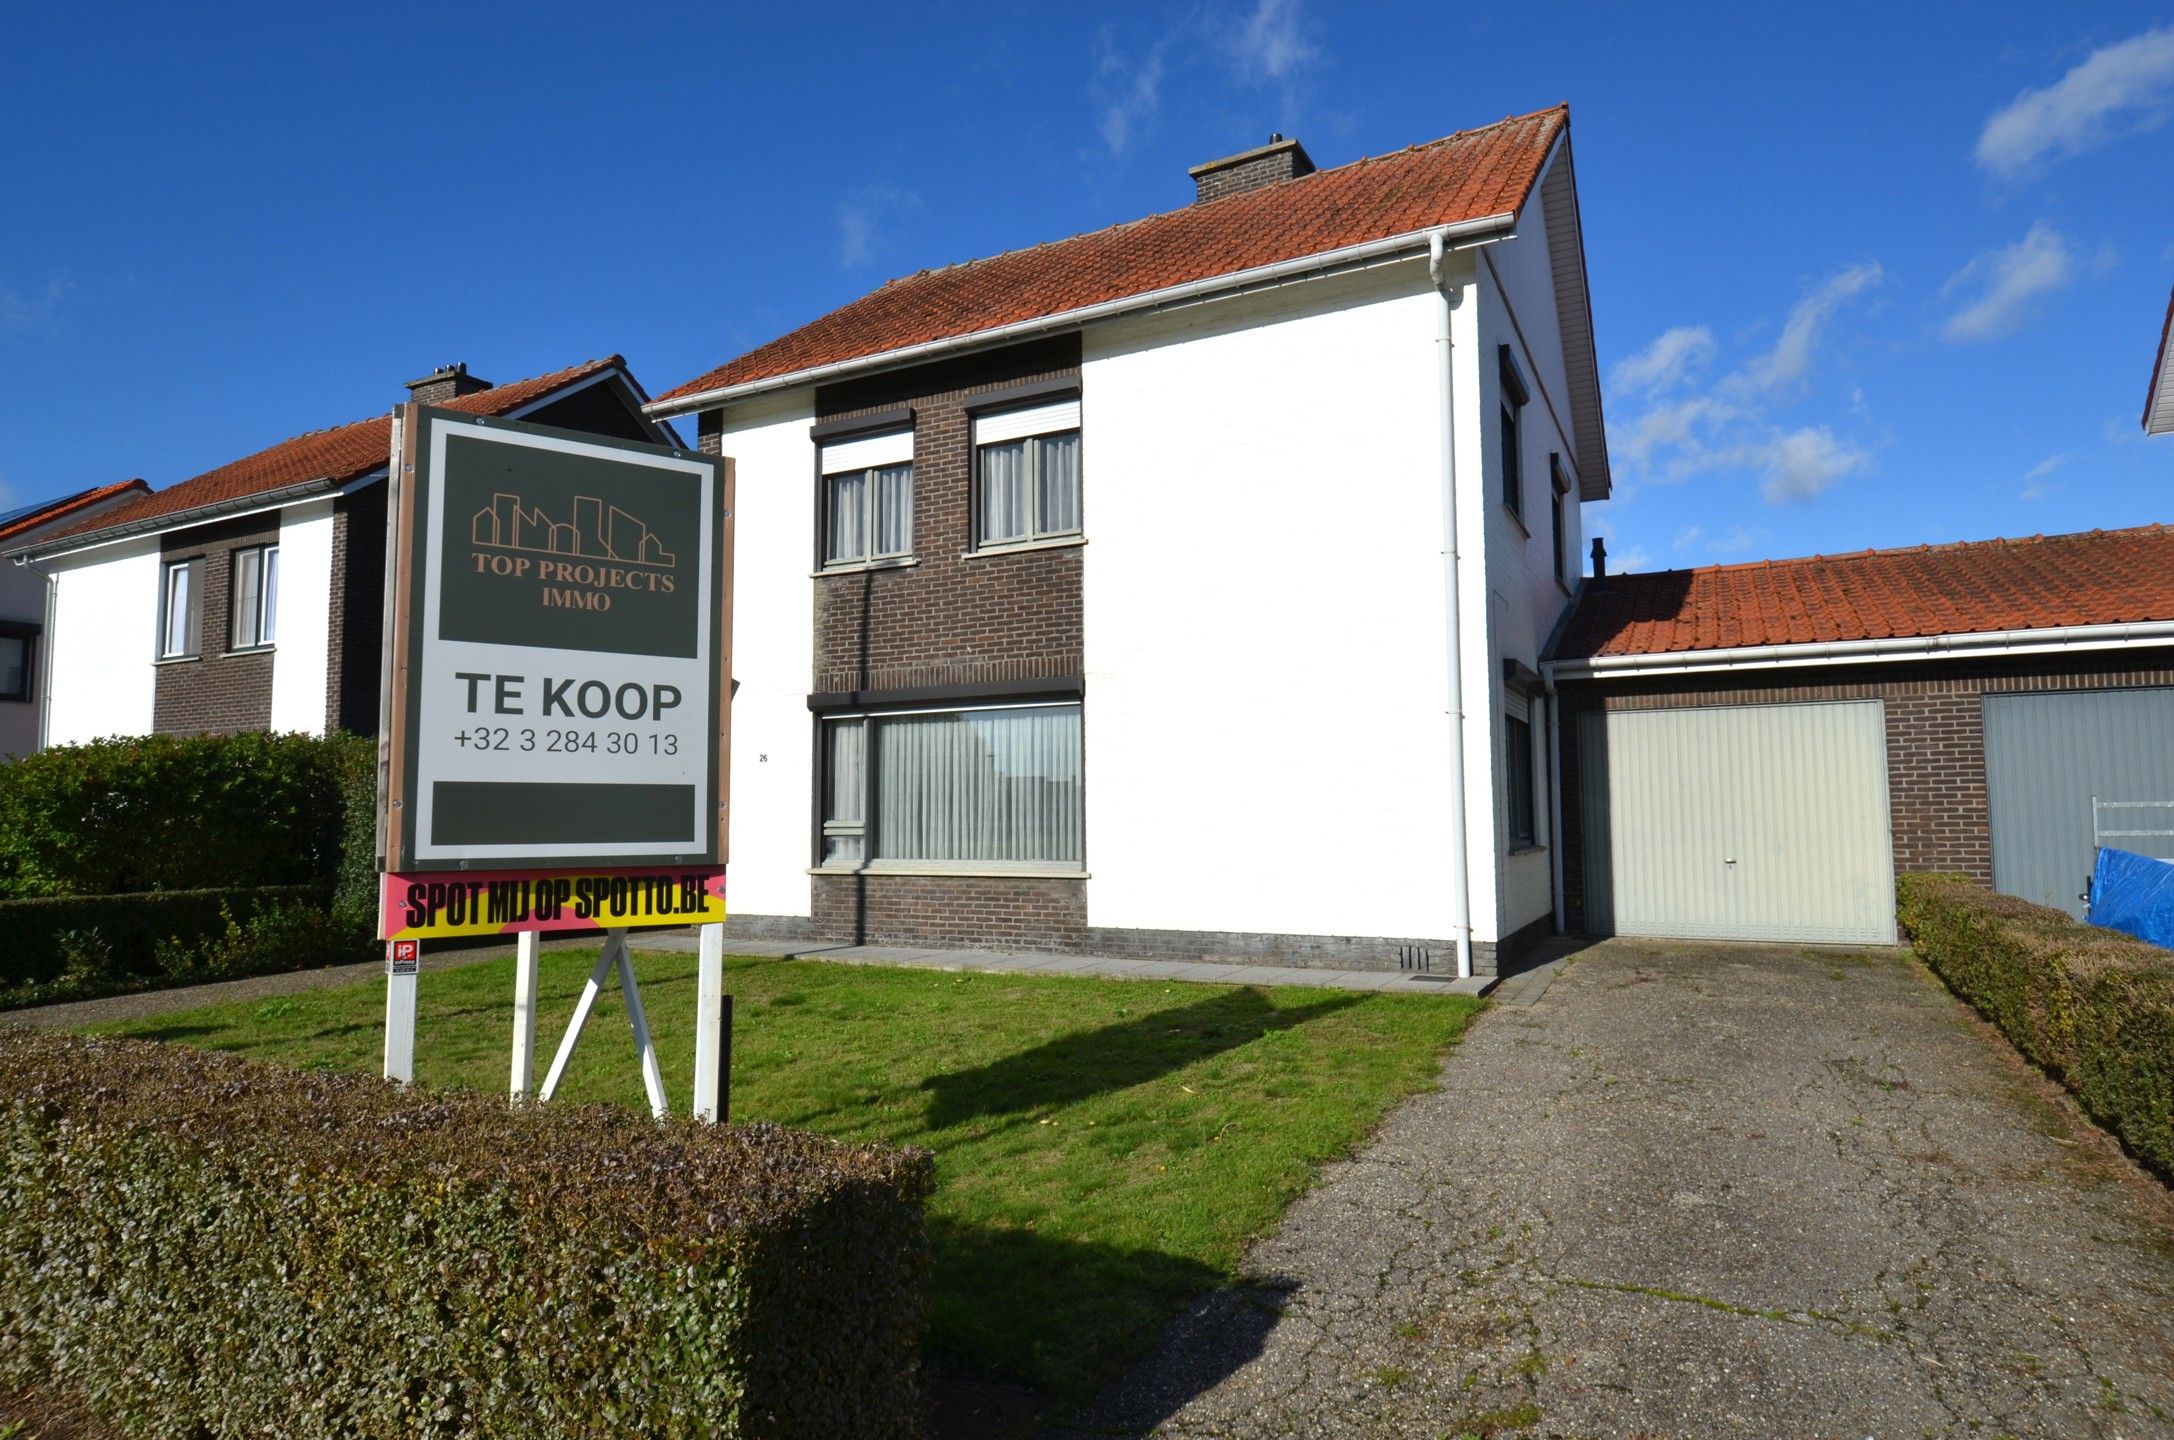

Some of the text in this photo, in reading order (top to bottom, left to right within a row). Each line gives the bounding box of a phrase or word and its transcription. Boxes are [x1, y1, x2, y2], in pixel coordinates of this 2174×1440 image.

[471, 553, 675, 593] TOP PROJECTS
[542, 586, 611, 612] IMMO
[455, 672, 682, 721] TE KOOP
[454, 727, 678, 755] +32 3 284 30 13
[759, 753, 768, 762] 26
[405, 874, 709, 929] SPOT MIJ OP SPOTTO.BE
